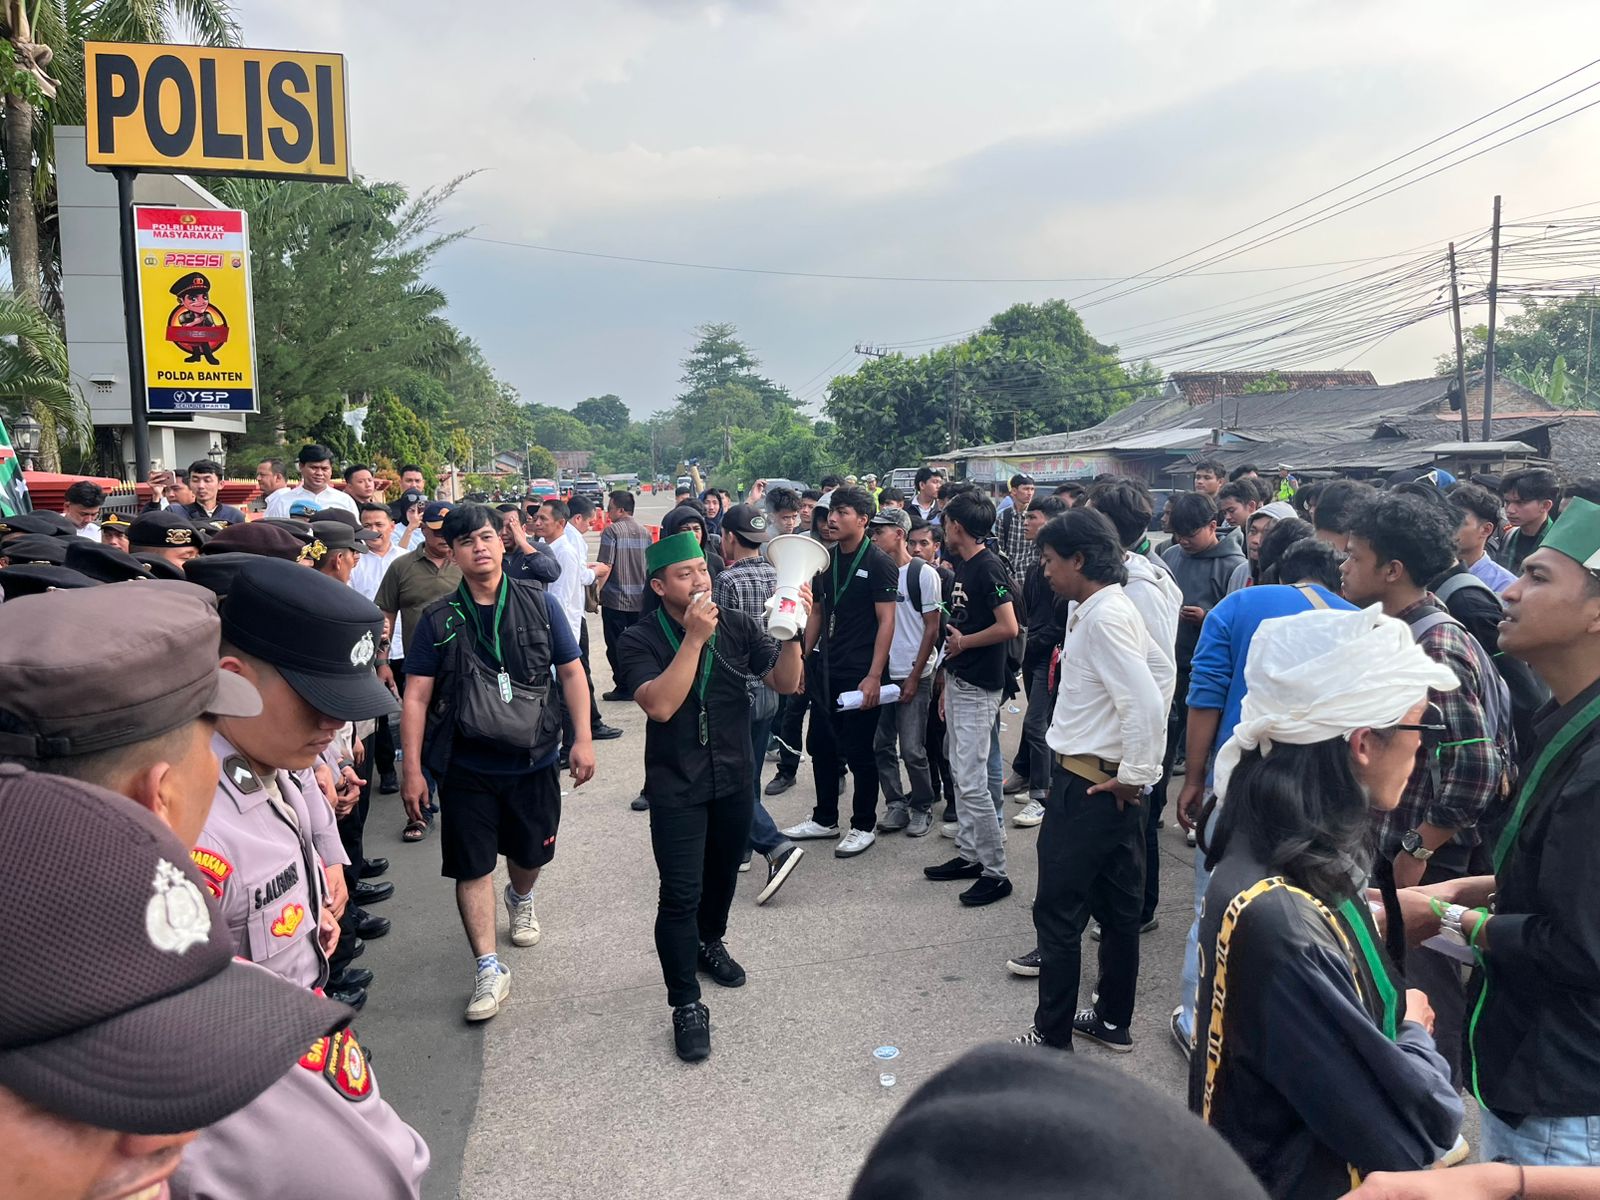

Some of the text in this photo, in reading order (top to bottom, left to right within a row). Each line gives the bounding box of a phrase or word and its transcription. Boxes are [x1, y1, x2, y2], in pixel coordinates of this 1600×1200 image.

[95, 53, 336, 165] POLISI
[152, 223, 224, 232] POLRI UNTUK
[153, 231, 224, 240] MASYARAKAT
[164, 252, 224, 268] PRESISI
[157, 371, 242, 381] POLDA BANTEN
[186, 391, 229, 403] YSP
